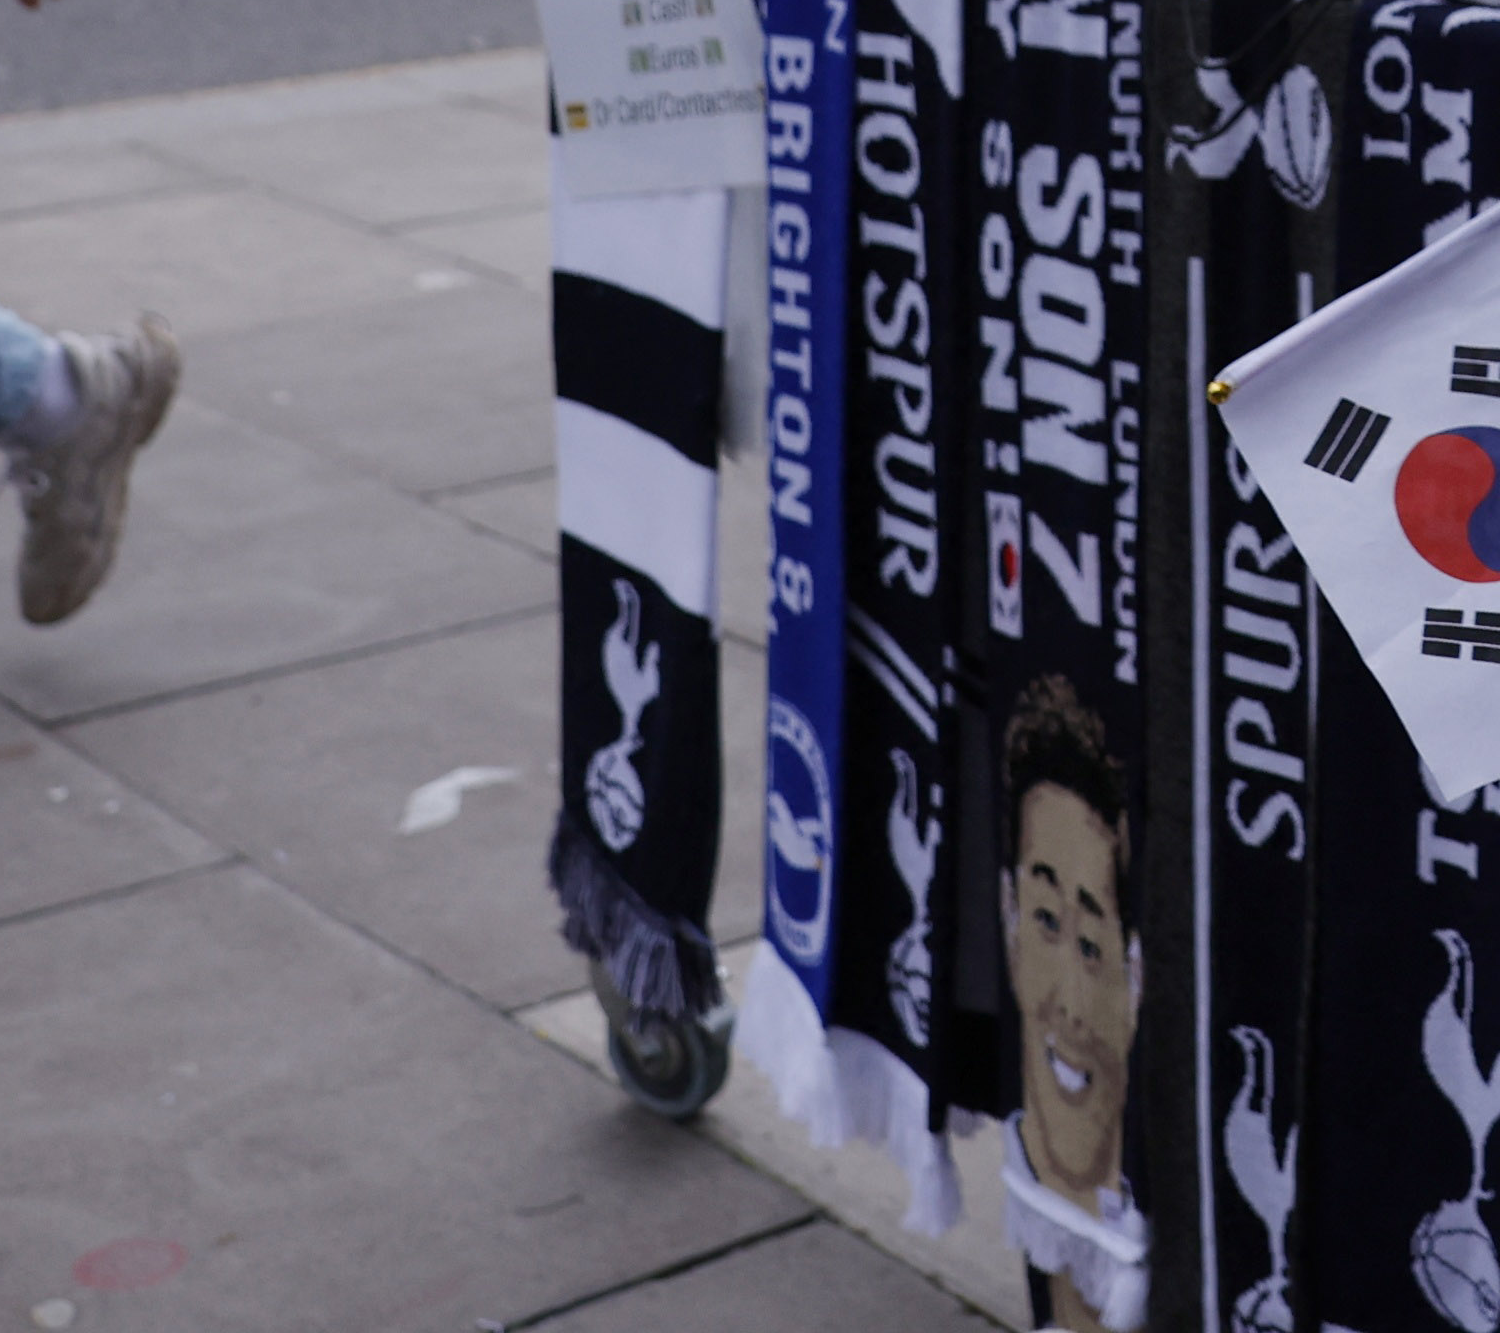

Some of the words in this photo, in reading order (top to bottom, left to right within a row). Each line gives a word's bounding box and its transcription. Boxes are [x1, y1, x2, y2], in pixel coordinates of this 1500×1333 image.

[765, 34, 814, 528] BRIGHTON
[854, 30, 940, 599] HOTSPUR
[979, 118, 1021, 477] SON!
[1016, 142, 1109, 487] SON
[1026, 510, 1102, 628] 7
